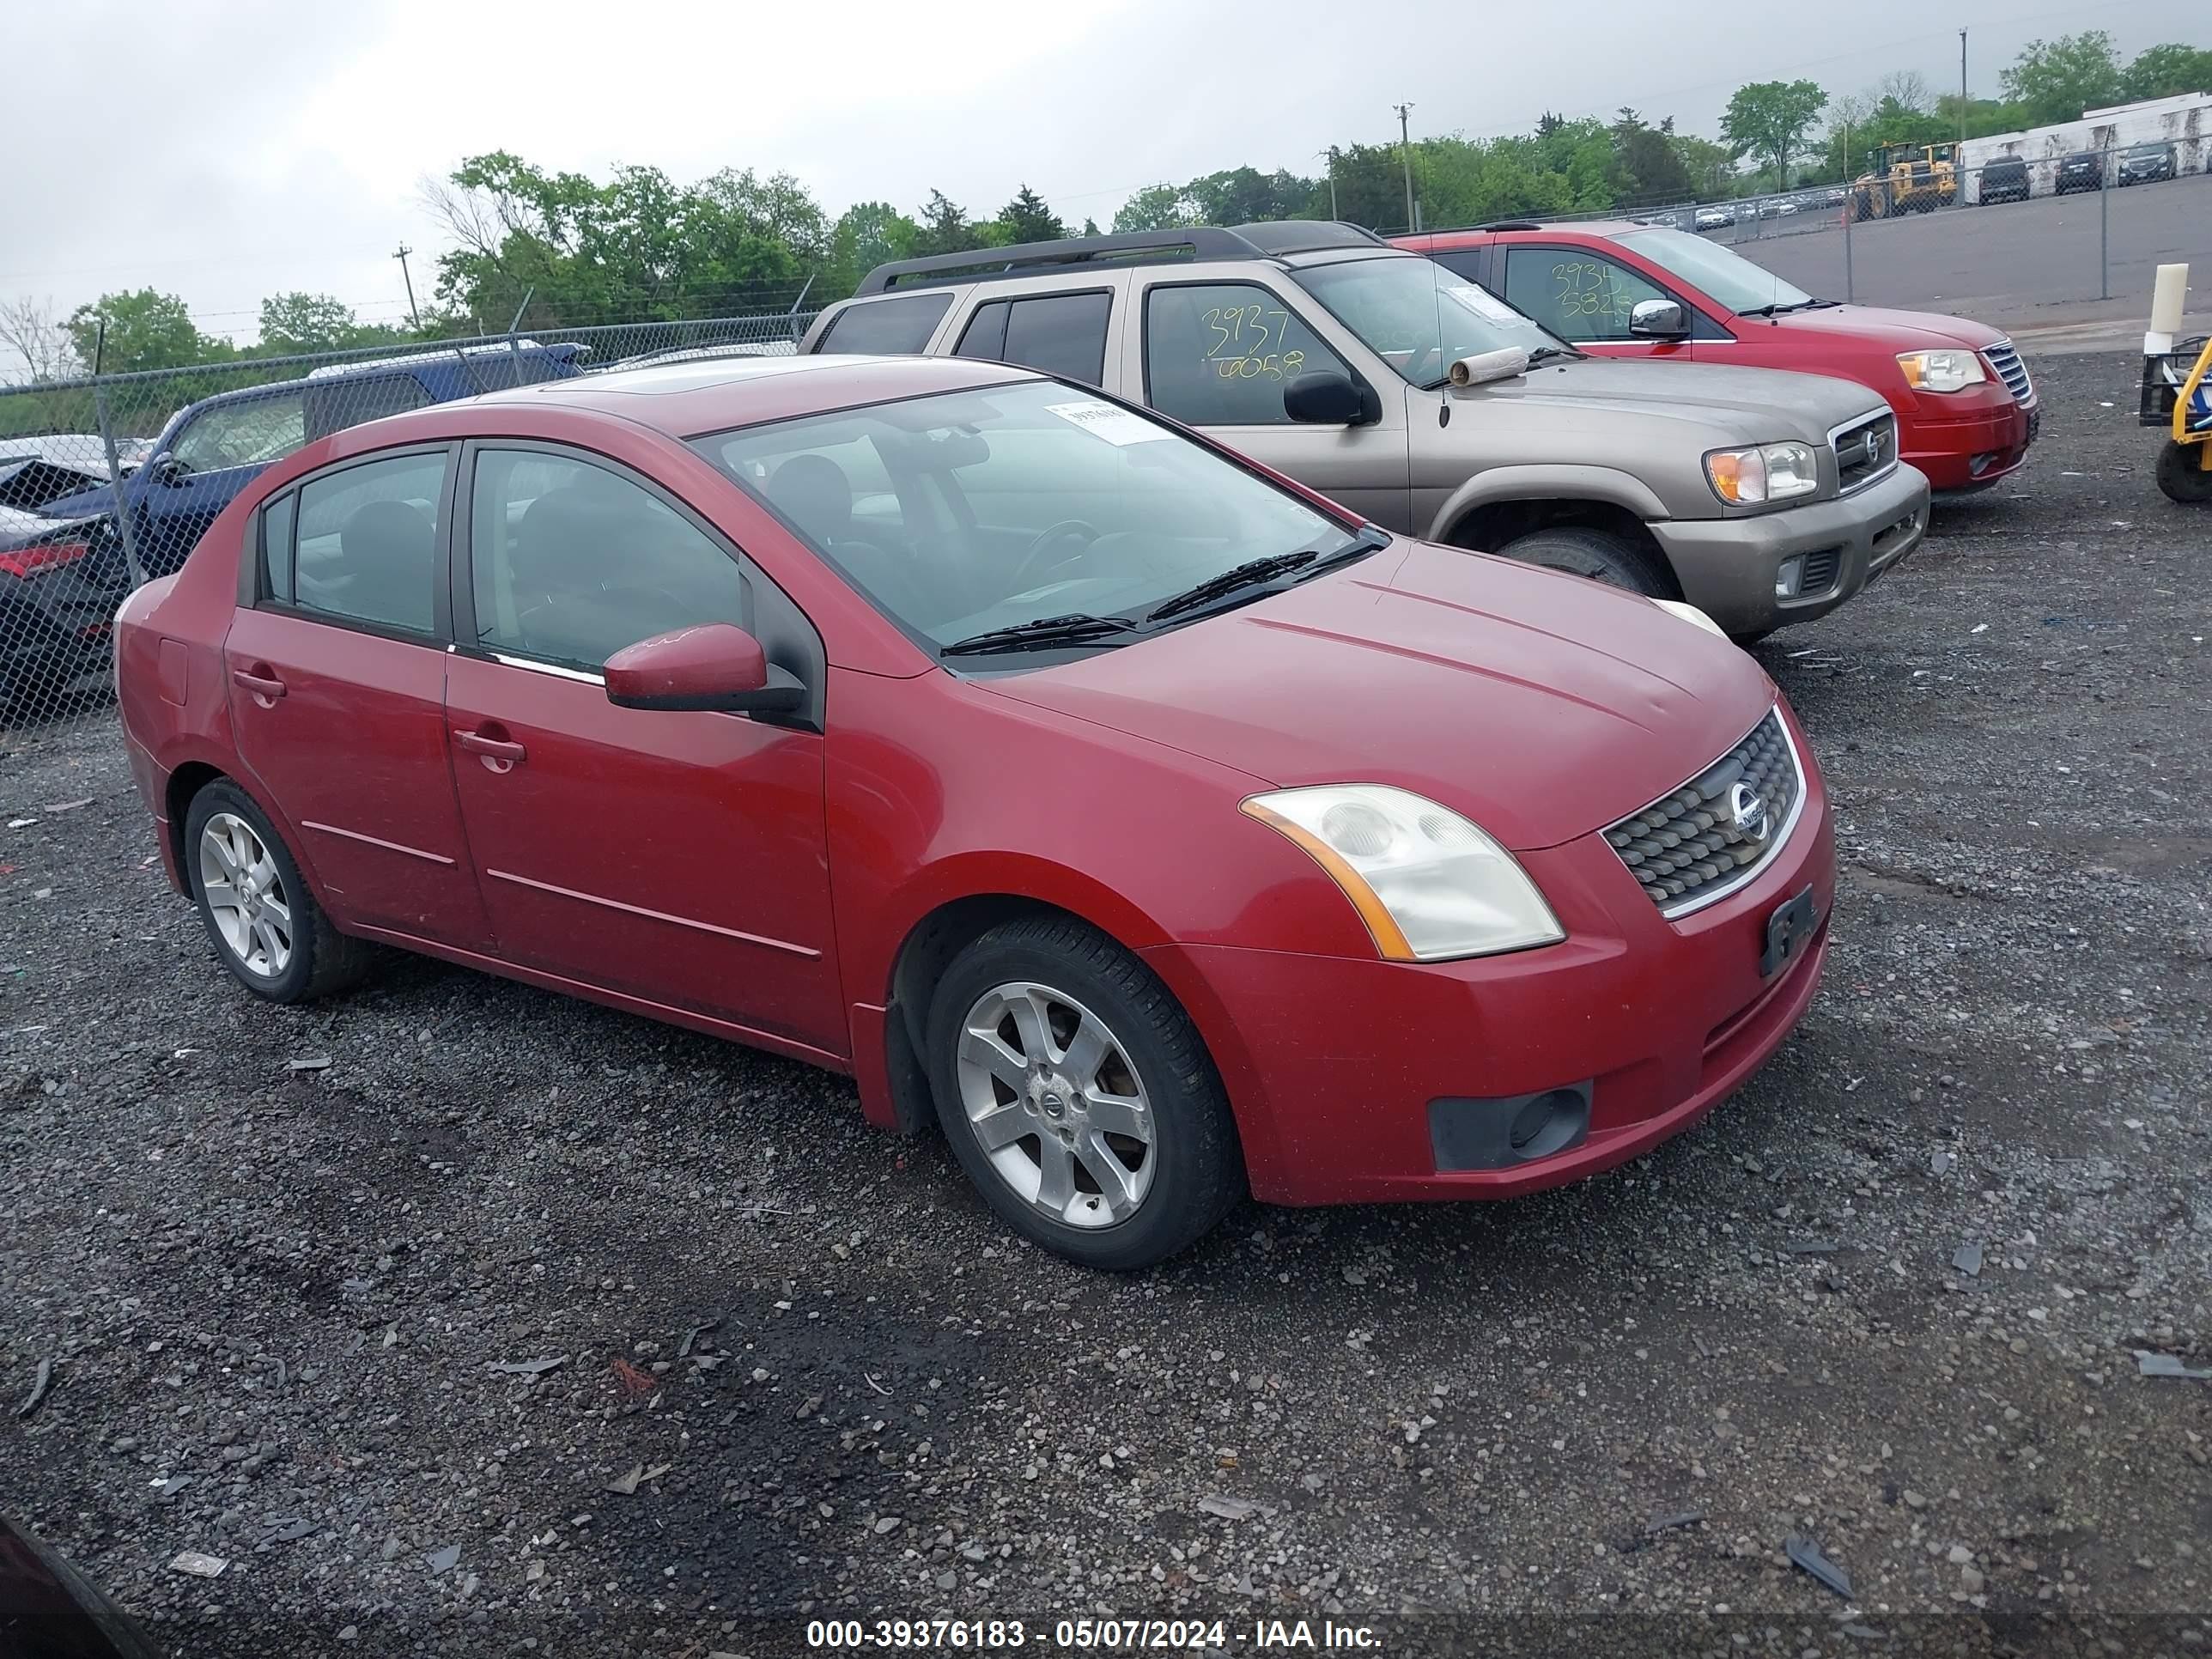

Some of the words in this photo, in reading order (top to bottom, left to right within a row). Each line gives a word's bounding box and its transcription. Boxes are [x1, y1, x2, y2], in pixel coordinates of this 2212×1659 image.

[1552, 263, 1622, 299] 3935
[1561, 292, 1633, 318] 5828
[1201, 305, 1290, 356] 3937
[1218, 349, 1305, 381] 6058
[1743, 802, 1765, 825] NISS
